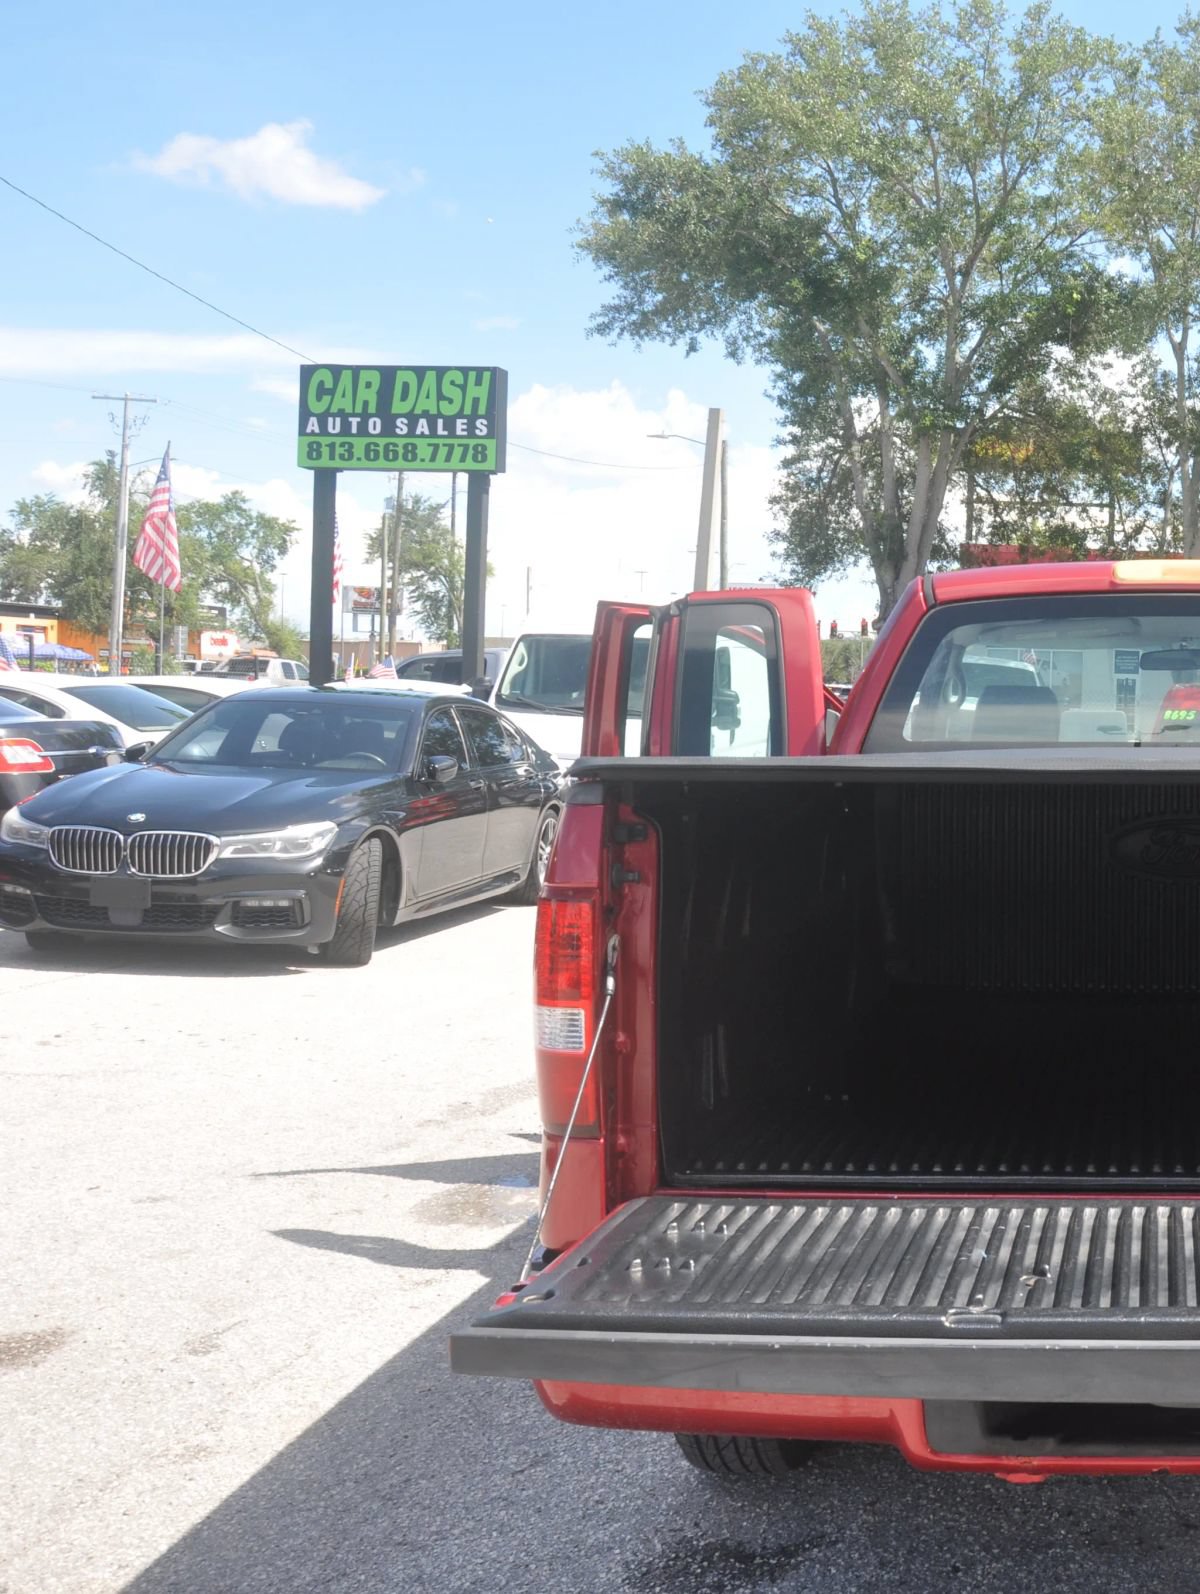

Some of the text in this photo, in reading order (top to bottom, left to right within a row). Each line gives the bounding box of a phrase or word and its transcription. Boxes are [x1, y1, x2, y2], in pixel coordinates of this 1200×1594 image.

[307, 368, 491, 416] CAR DASH
[306, 416, 488, 436] AUTO SALES
[306, 440, 488, 464] 813.668.7778
